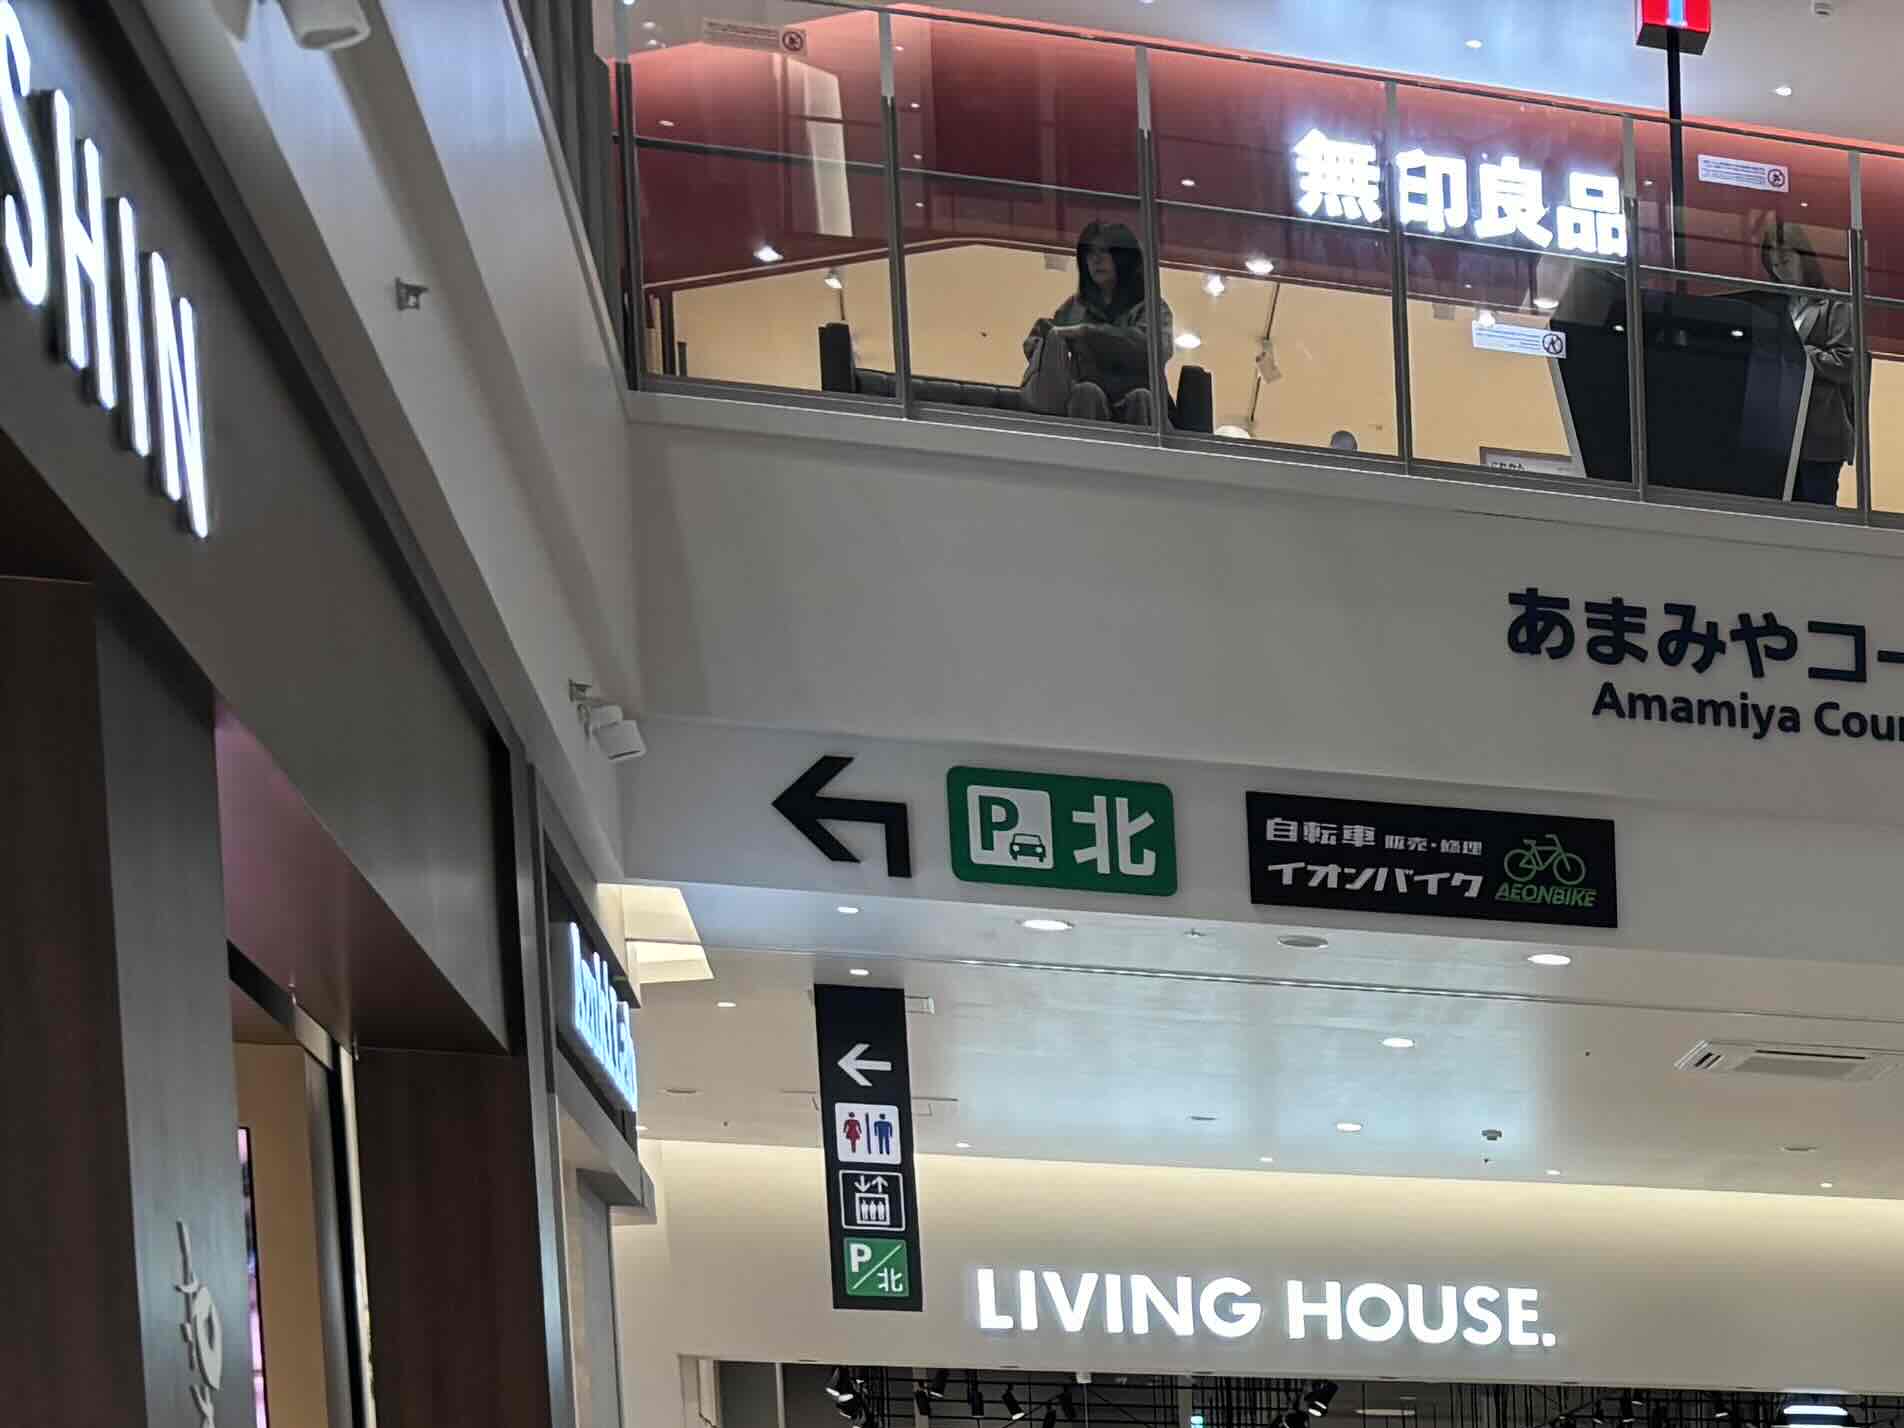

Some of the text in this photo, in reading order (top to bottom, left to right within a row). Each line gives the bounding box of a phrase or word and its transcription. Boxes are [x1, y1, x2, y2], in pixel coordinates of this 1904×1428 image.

[1292, 128, 1626, 258] 無印良品
[1592, 681, 1800, 740] Amamiya
[1072, 795, 1156, 876] 北
[1266, 817, 1376, 847] 自転車
[1268, 862, 1483, 898] イオンバイク
[1495, 882, 1598, 907] AEONBIKE
[850, 1244, 872, 1273] P
[876, 1267, 904, 1292] 北
[976, 1267, 1556, 1348] LIVING HOUSE.
